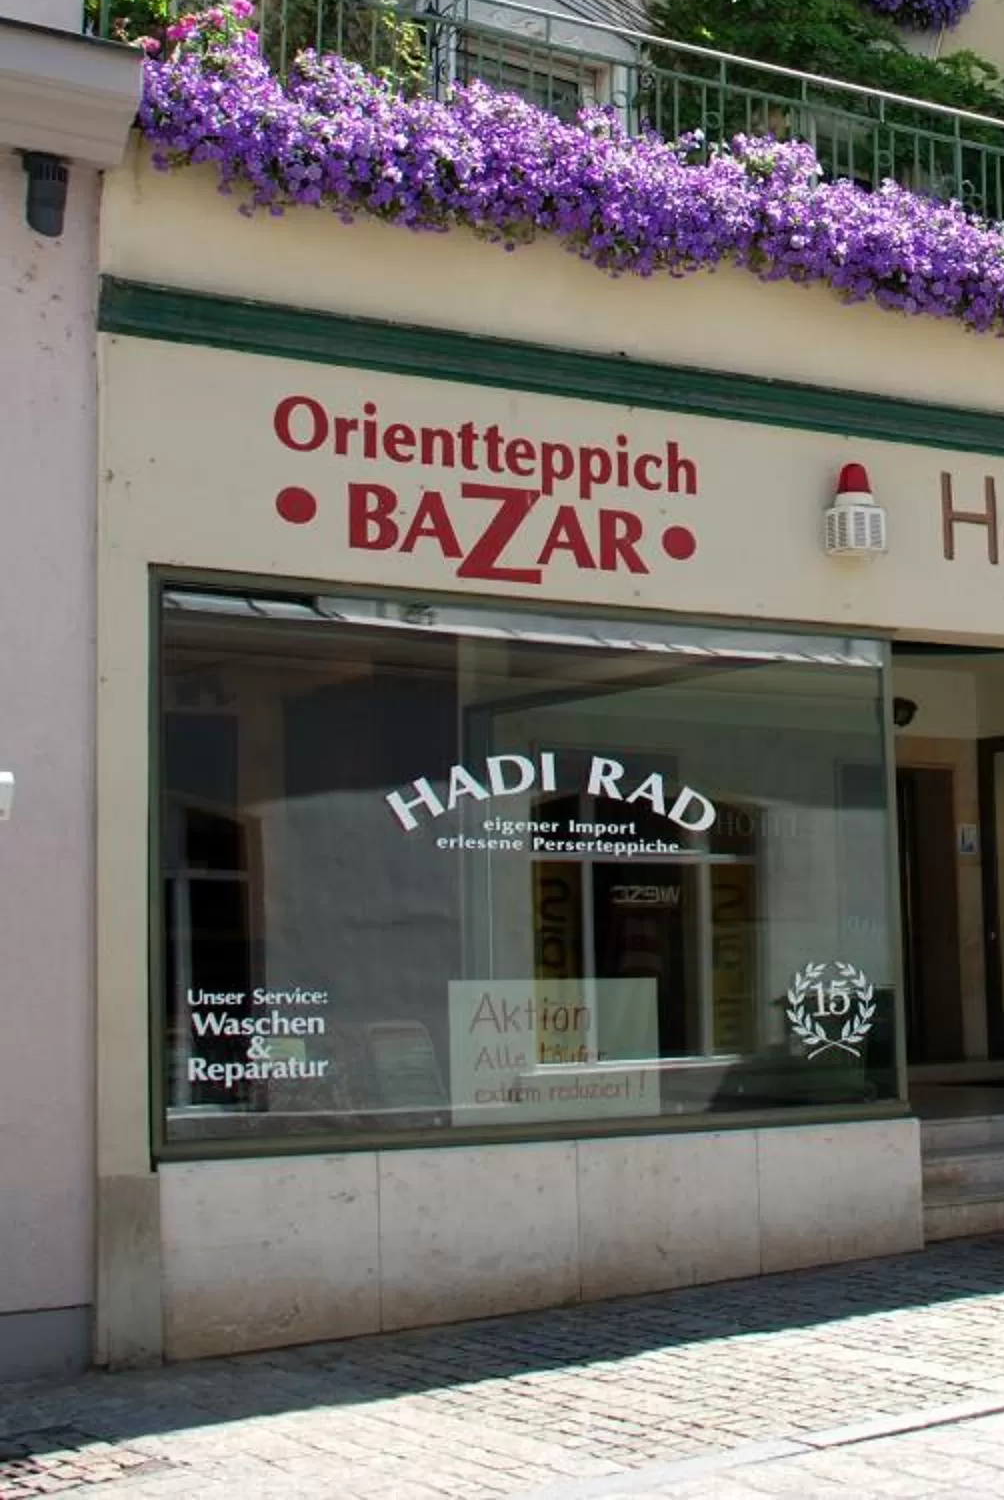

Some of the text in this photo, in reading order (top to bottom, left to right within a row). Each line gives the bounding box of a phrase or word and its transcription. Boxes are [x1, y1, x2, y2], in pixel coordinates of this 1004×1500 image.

[273, 395, 698, 496] Orientteppich
[347, 482, 650, 584] BAZAR
[385, 752, 717, 832] HADI RAD
[483, 817, 636, 837] eigener Import
[436, 834, 680, 857] erlesene Perserteppiche
[187, 986, 328, 1006] Unser Service:
[810, 979, 851, 1017] 15
[191, 1009, 325, 1036] Waschen
[468, 992, 592, 1035] Aktion
[247, 1035, 272, 1059] &
[474, 1045, 528, 1072] Alle
[187, 1056, 329, 1088] Reparatur
